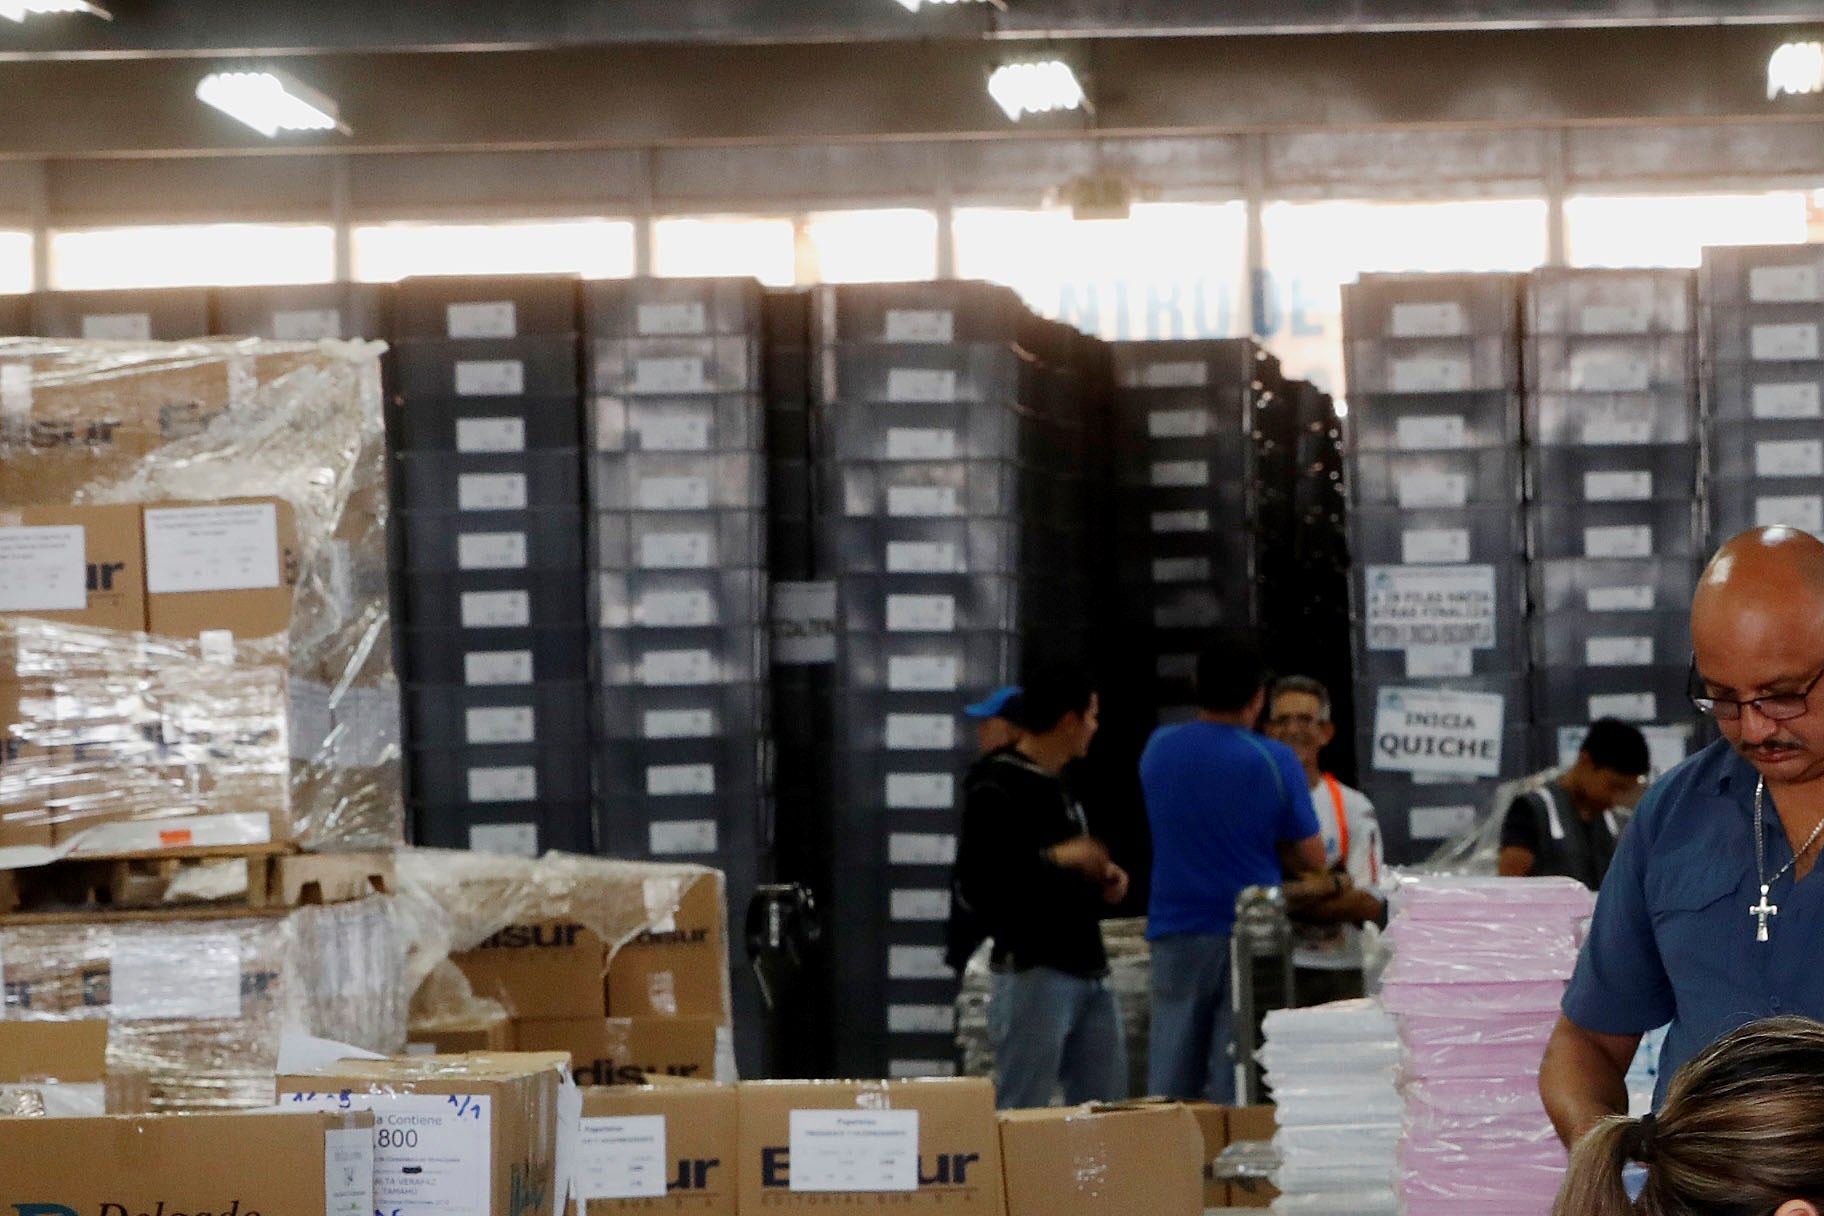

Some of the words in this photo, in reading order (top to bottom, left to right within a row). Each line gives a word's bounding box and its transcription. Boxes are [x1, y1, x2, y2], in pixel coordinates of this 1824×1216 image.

[1404, 711, 1476, 730] INICIA
[1378, 732, 1497, 761] QUICHE
[387, 1113, 443, 1127] Contiene
